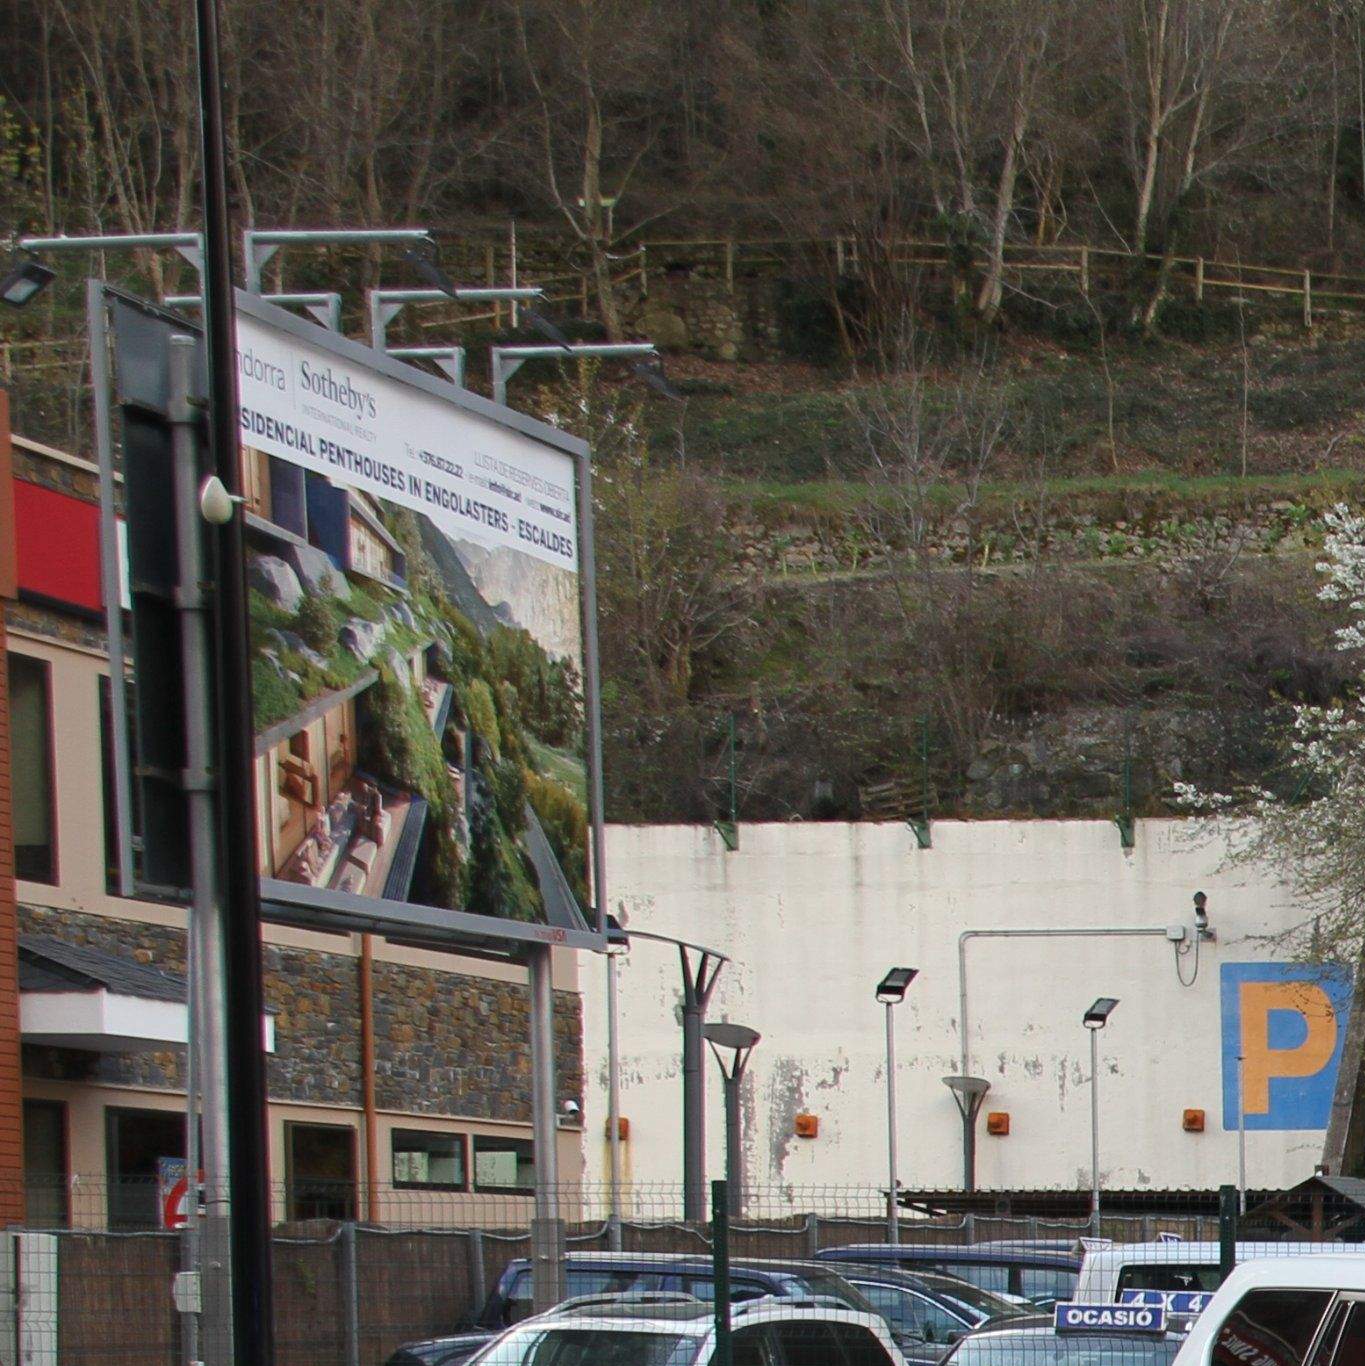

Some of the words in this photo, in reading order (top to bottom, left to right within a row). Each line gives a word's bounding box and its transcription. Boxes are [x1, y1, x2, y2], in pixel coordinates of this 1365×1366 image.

[235, 348, 285, 391] ndorra
[301, 359, 376, 420] Sotheby's
[239, 406, 316, 457] SIDENCIAL
[319, 438, 406, 492] PENTHOUSES
[408, 474, 422, 498] IN
[424, 480, 509, 533] ENGOLASTERS
[517, 518, 573, 558] ESCALDES
[1239, 979, 1338, 1115] P
[1065, 1307, 1153, 1327] OCASIÓ
